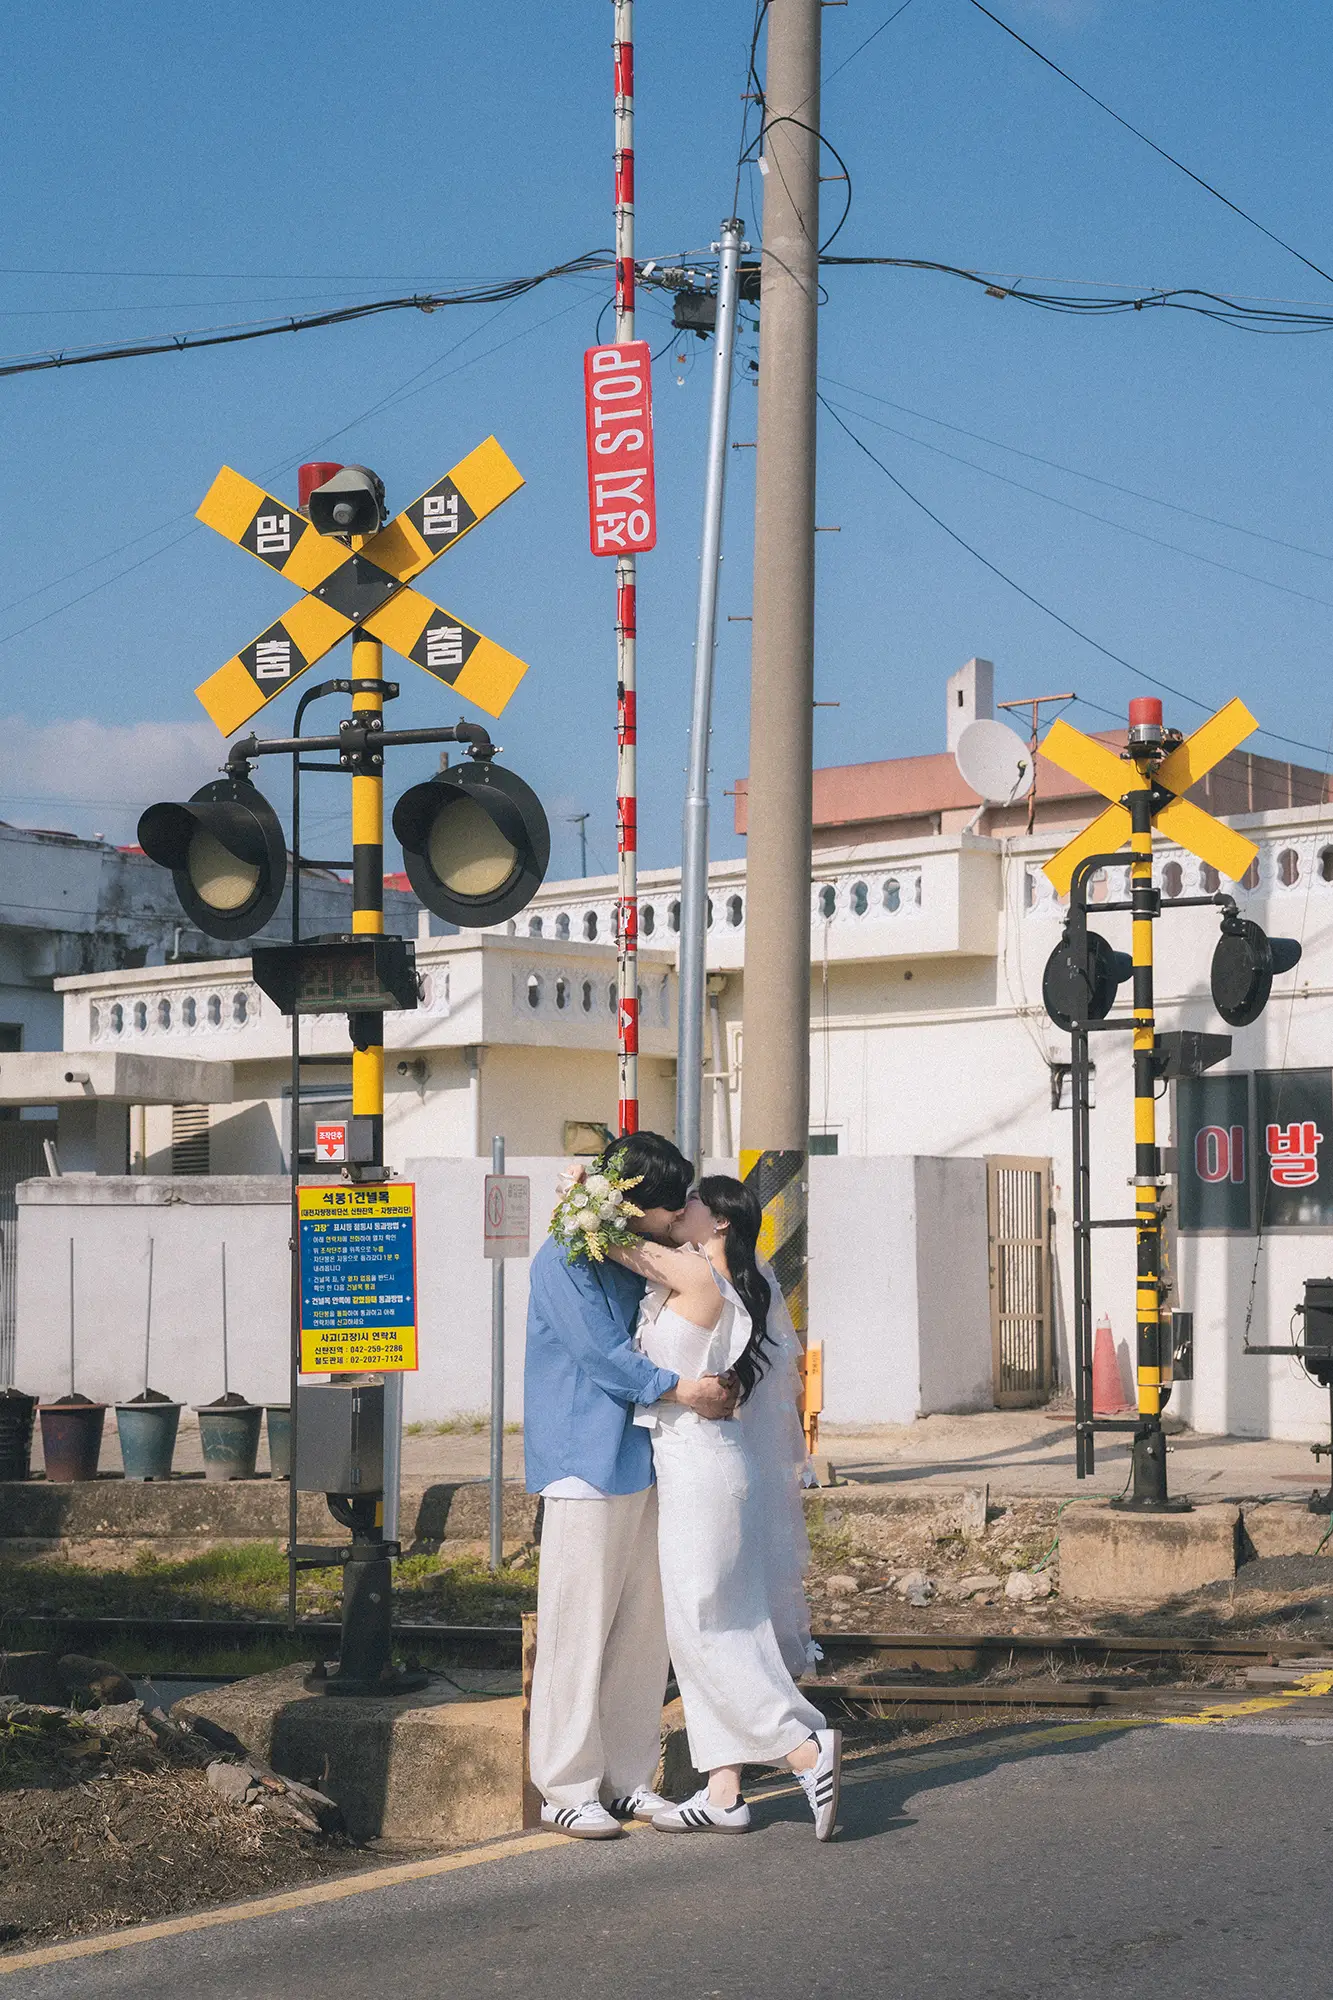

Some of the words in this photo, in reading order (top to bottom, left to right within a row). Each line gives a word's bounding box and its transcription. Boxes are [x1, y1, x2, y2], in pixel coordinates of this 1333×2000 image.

[592, 349, 644, 455] STOP
[423, 494, 458, 536] 멈
[595, 467, 650, 548] 정지
[256, 514, 290, 554] 멈
[256, 640, 290, 680] 춤
[426, 626, 462, 667] 춤
[319, 1131, 342, 1140] 조작단추
[1194, 1125, 1245, 1184] 이
[1266, 1121, 1324, 1188] 발
[322, 1192, 390, 1205] 석봉1건널목
[374, 1222, 399, 1230] 통과방법
[314, 1346, 343, 1354] 신탄진역
[321, 1332, 368, 1342] 사고(고장)시
[372, 1331, 397, 1341] 연락처
[350, 1355, 403, 1363] 02-2027-7124
